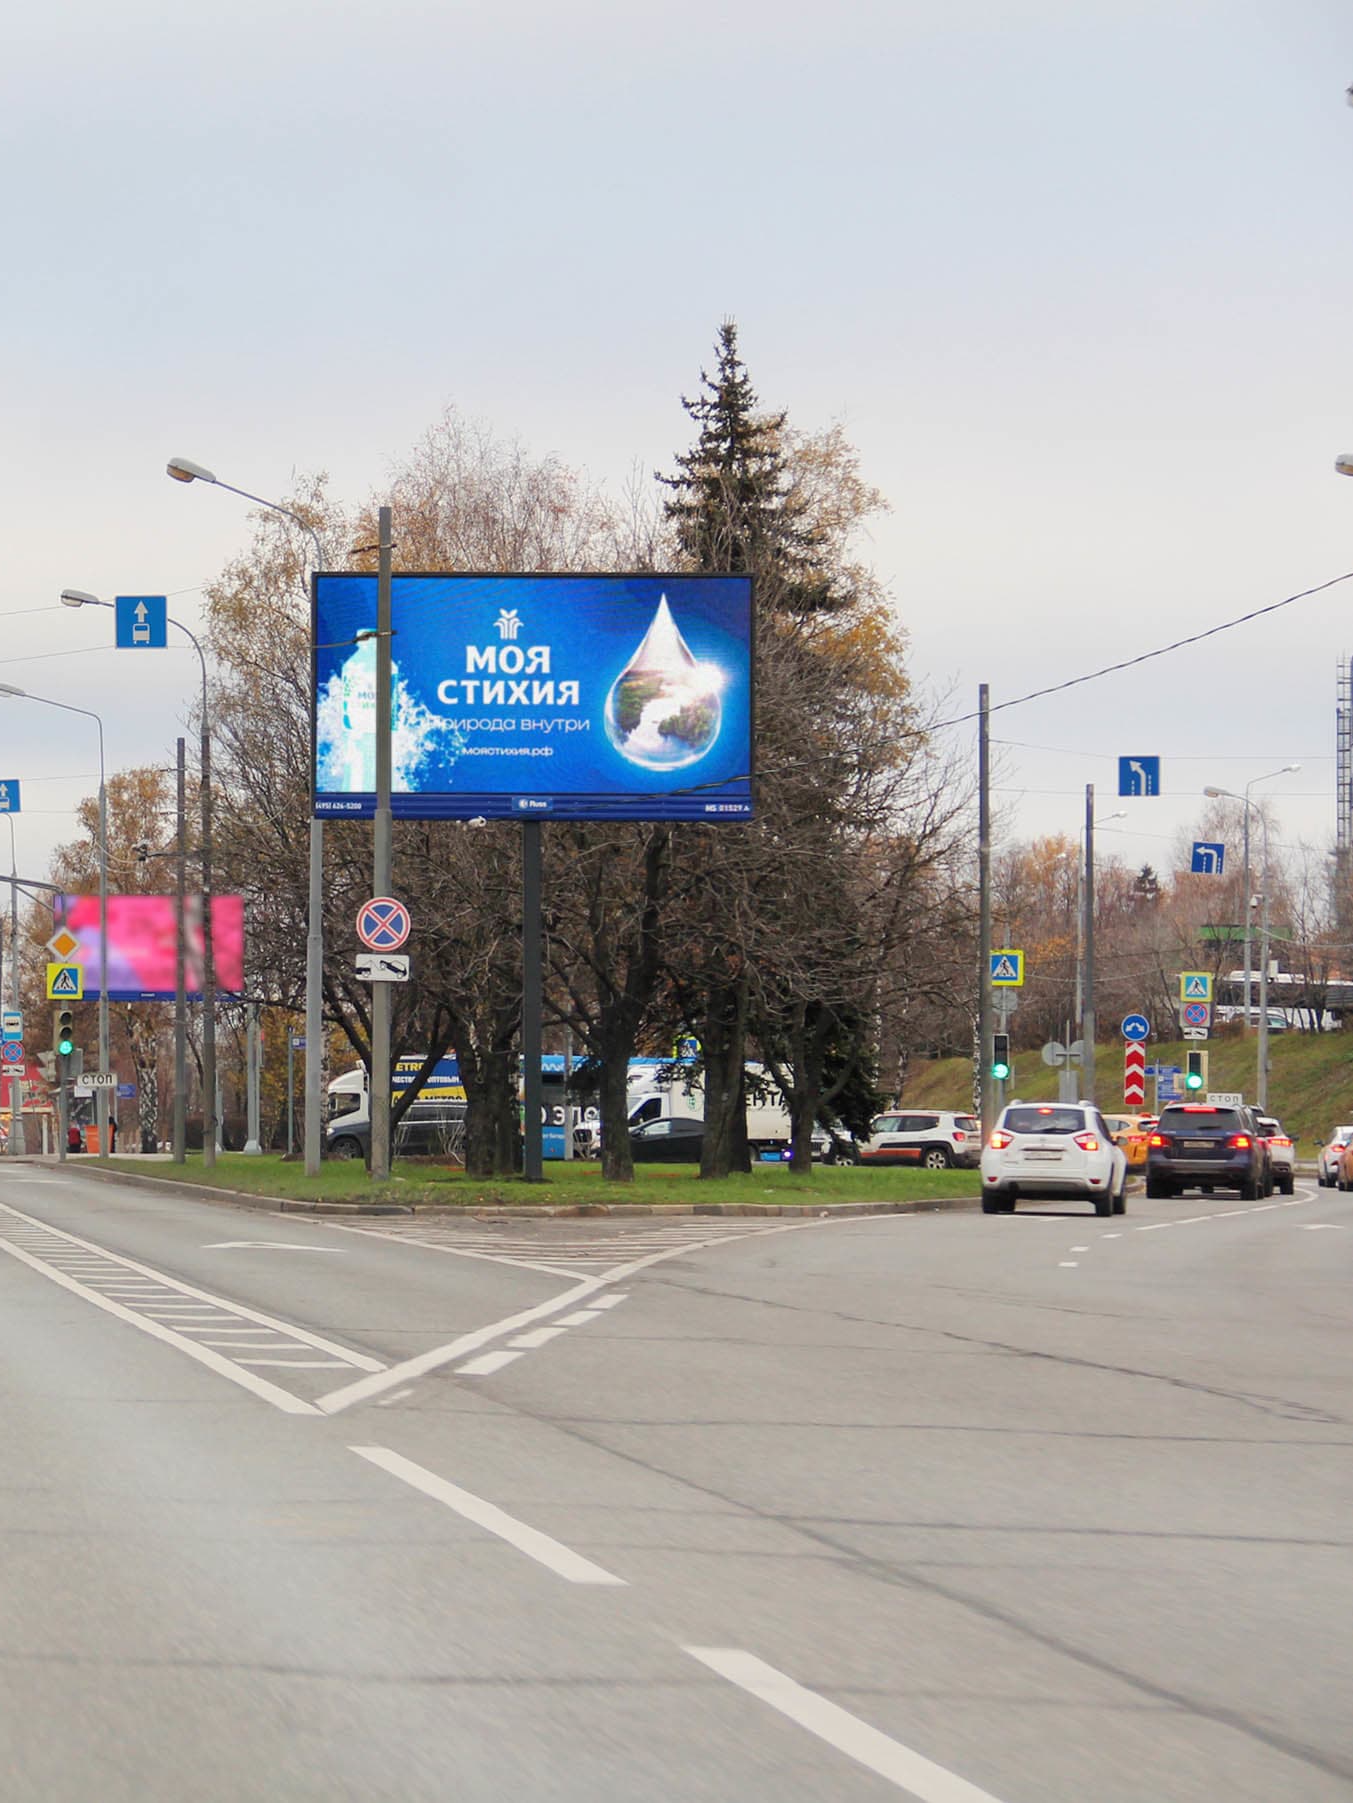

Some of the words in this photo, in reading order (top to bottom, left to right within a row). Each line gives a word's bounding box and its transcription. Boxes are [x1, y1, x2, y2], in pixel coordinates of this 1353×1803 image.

[466, 646, 550, 674] МОЯ
[437, 679, 579, 705] СТИХИЯ
[440, 718, 515, 733] рирода
[520, 718, 590, 734] внутри
[82, 1074, 113, 1085] СТОП
[1210, 1095, 1239, 1103] СТОП
